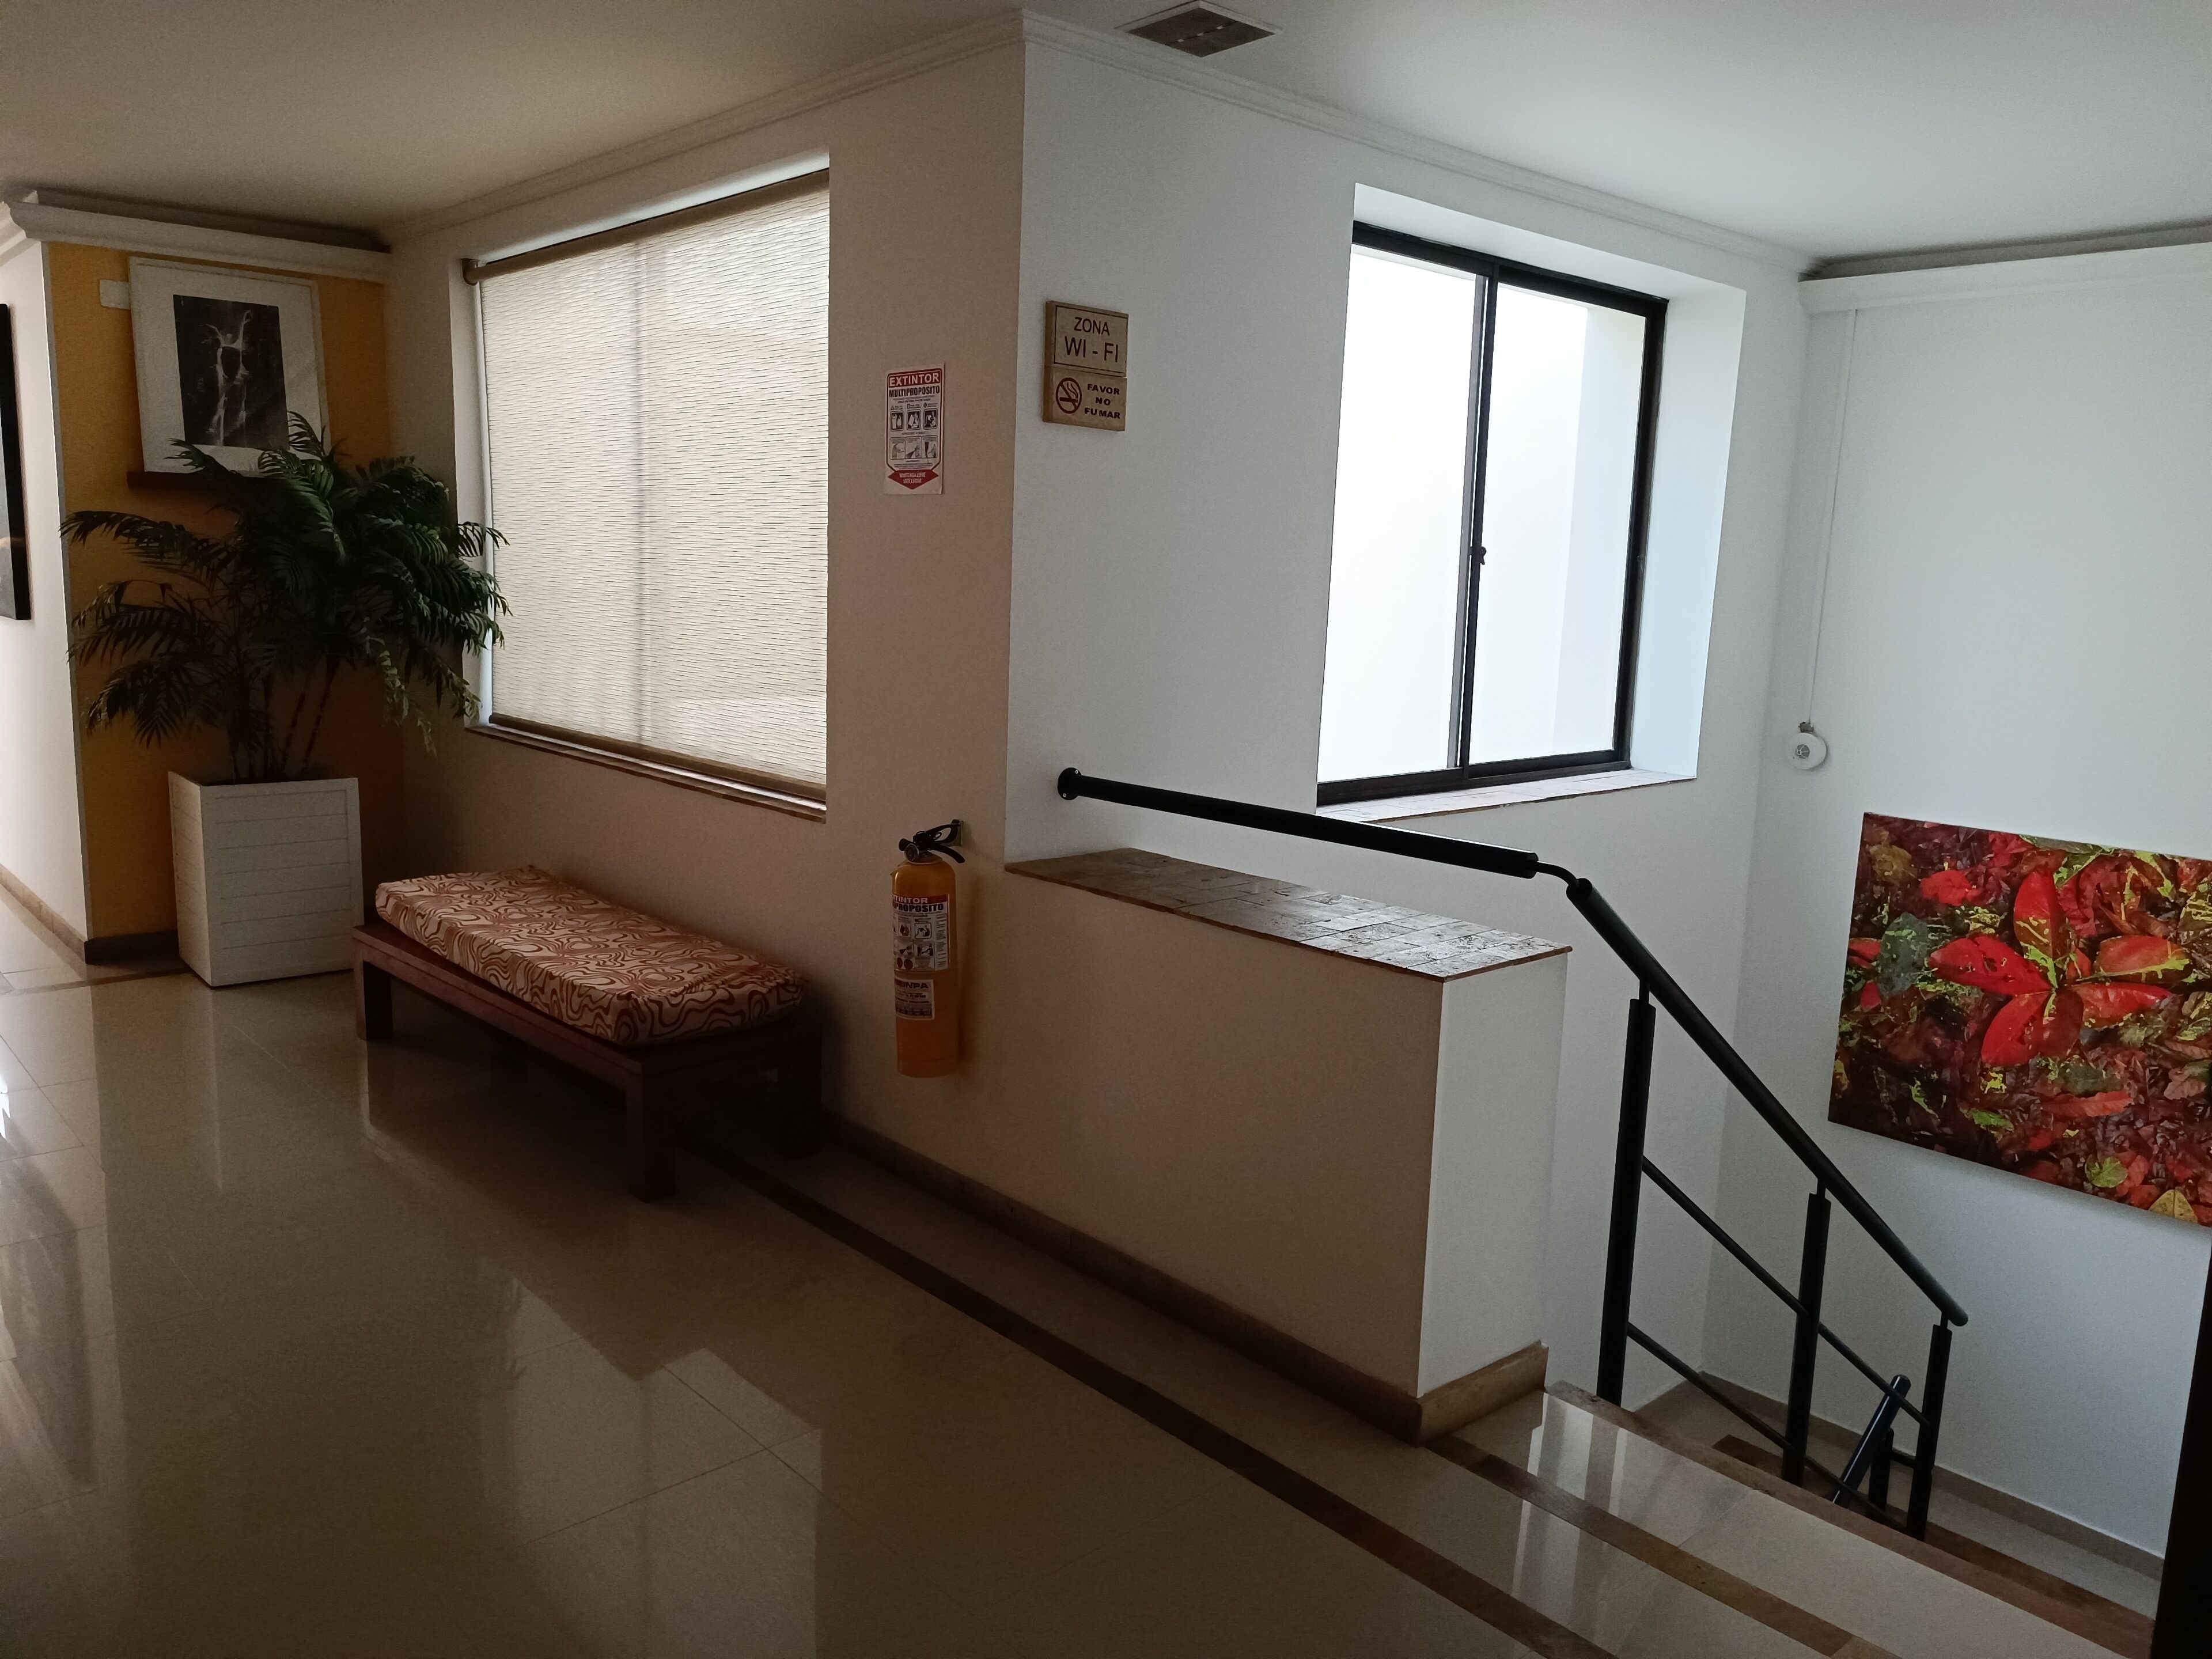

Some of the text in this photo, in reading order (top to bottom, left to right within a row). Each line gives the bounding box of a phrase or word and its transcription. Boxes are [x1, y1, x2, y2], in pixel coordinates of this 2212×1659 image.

[1074, 317, 1109, 336] ZONA
[889, 372, 940, 387] EXTINTOR
[1087, 383, 1120, 395] FAVOR
[1095, 397, 1111, 406] NO
[1084, 407, 1120, 419] FUMAR
